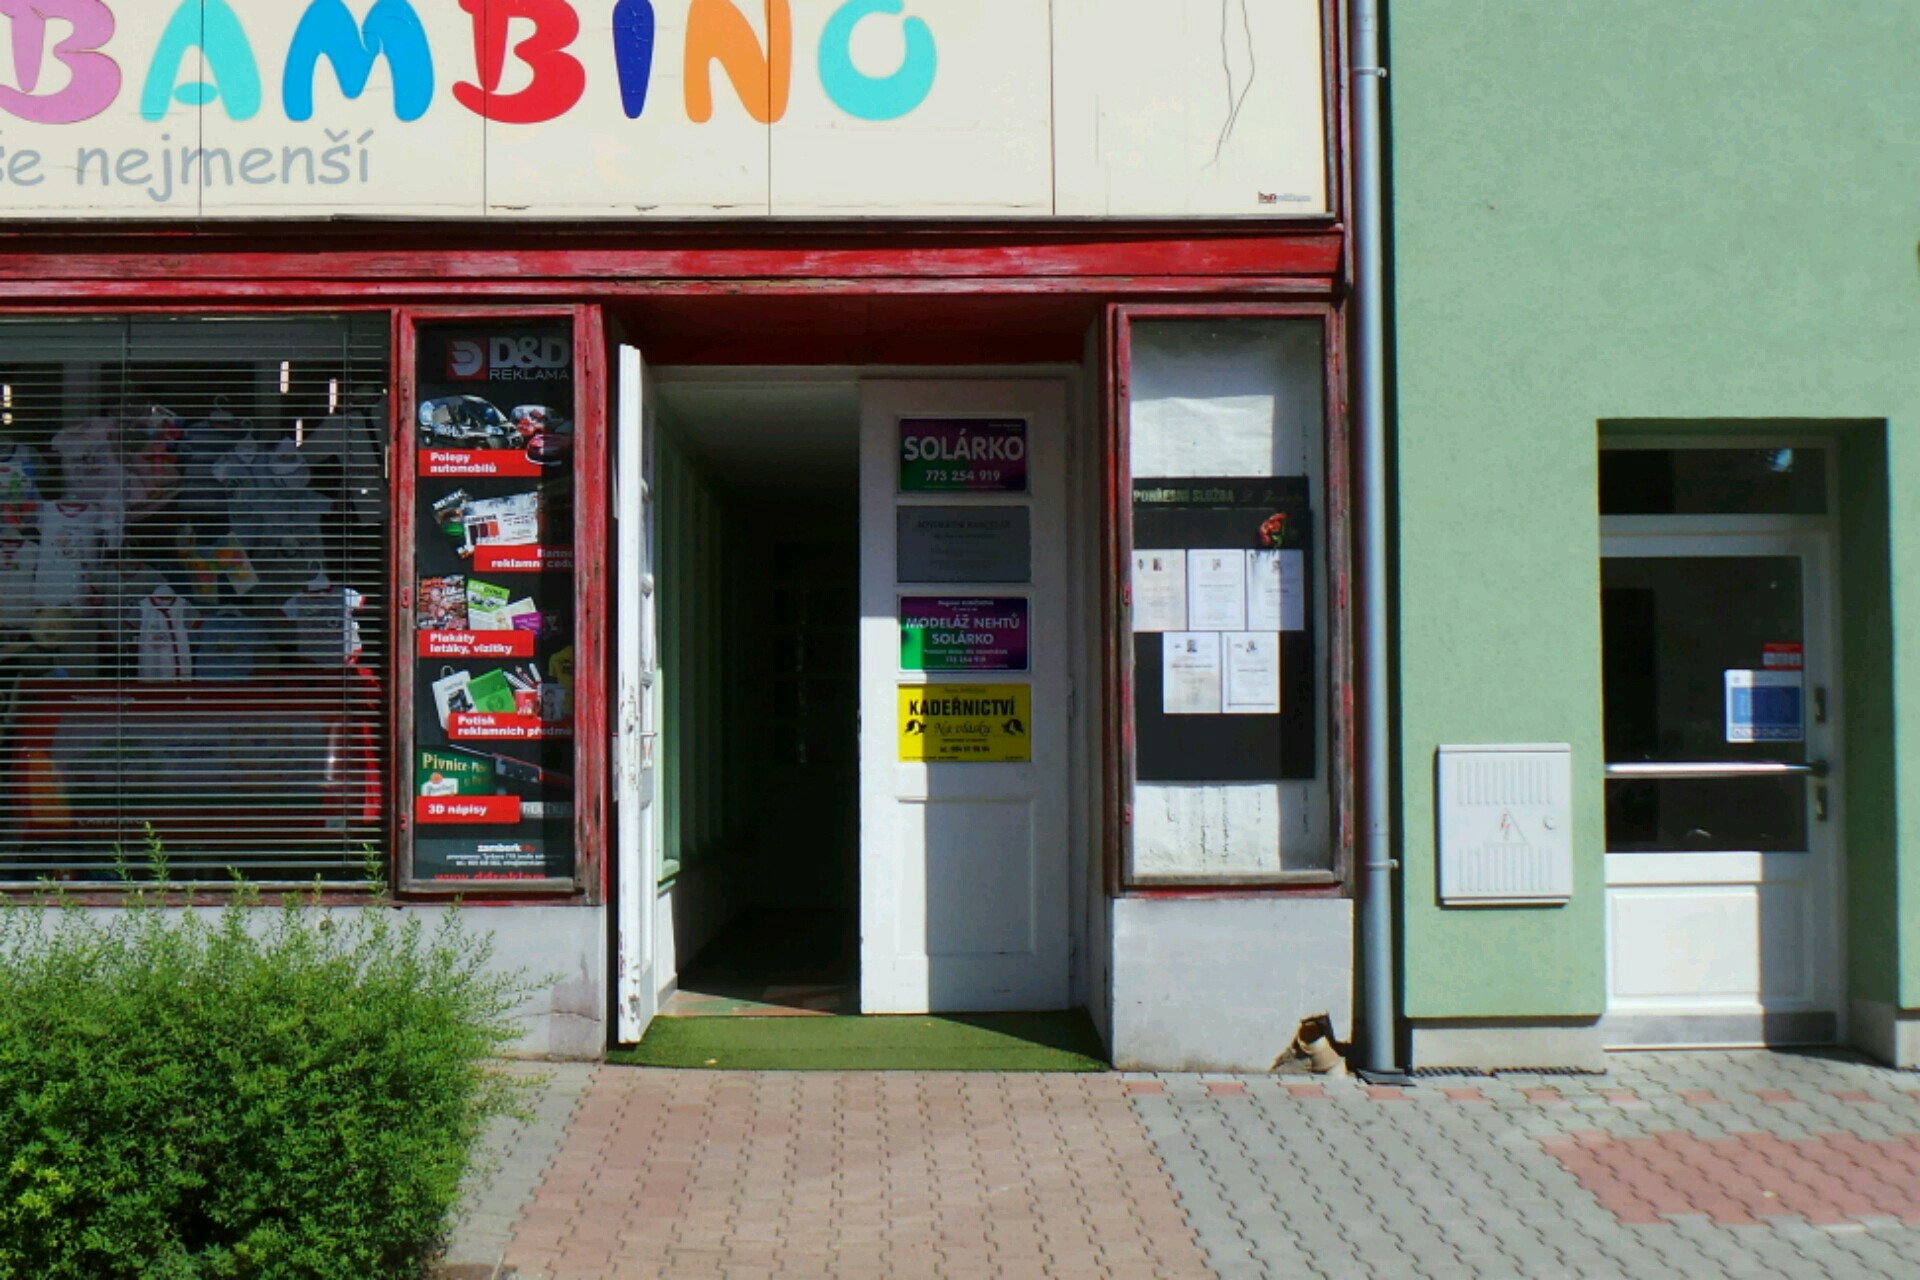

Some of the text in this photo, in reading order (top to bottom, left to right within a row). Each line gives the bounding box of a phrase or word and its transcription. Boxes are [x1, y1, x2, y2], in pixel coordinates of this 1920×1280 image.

[0, 0, 936, 124] BAMBINO
[76, 128, 374, 203] nejmenší
[489, 336, 570, 368] D&D
[489, 369, 569, 381] REKLAMA
[903, 428, 1025, 462] SOLÁRKO
[430, 452, 471, 463] Polepy
[430, 463, 497, 473] automobilů
[925, 469, 1001, 481] 773 254 919
[906, 612, 1020, 630] MODELÁŽ NEHTŮ
[430, 633, 476, 645] Plakáty
[932, 630, 995, 645] SOLÁRKO
[474, 643, 513, 655] vizitky
[909, 696, 1015, 716] KADEŘNICTVÍ
[457, 715, 495, 725] Potisk
[428, 803, 488, 817] 3D nápisy
